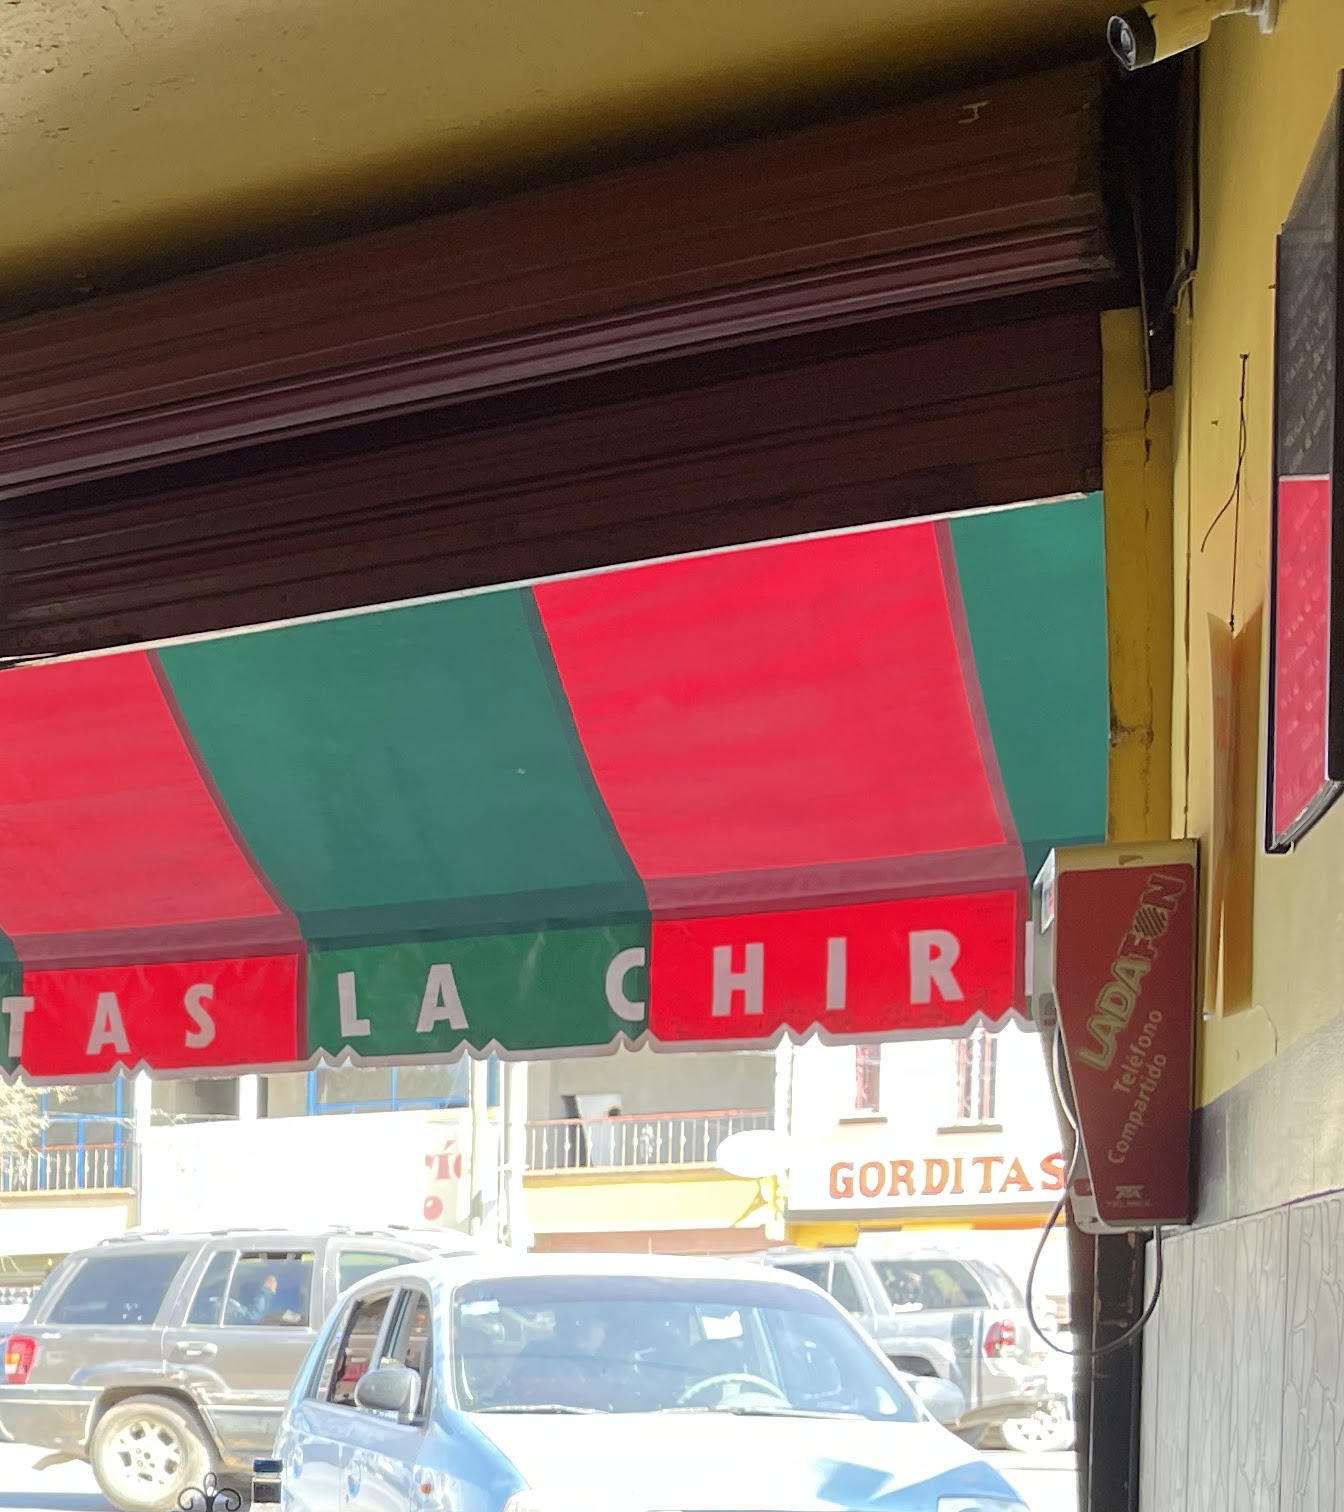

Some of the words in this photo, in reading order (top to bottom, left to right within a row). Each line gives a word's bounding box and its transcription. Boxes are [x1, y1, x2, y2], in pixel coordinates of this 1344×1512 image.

[336, 963, 470, 1038] LA
[605, 928, 965, 1022] CHIR
[1112, 1009, 1163, 1094] Teléfono
[1107, 1053, 1168, 1164] Compartido
[828, 1151, 1068, 1200] GORDITAS
